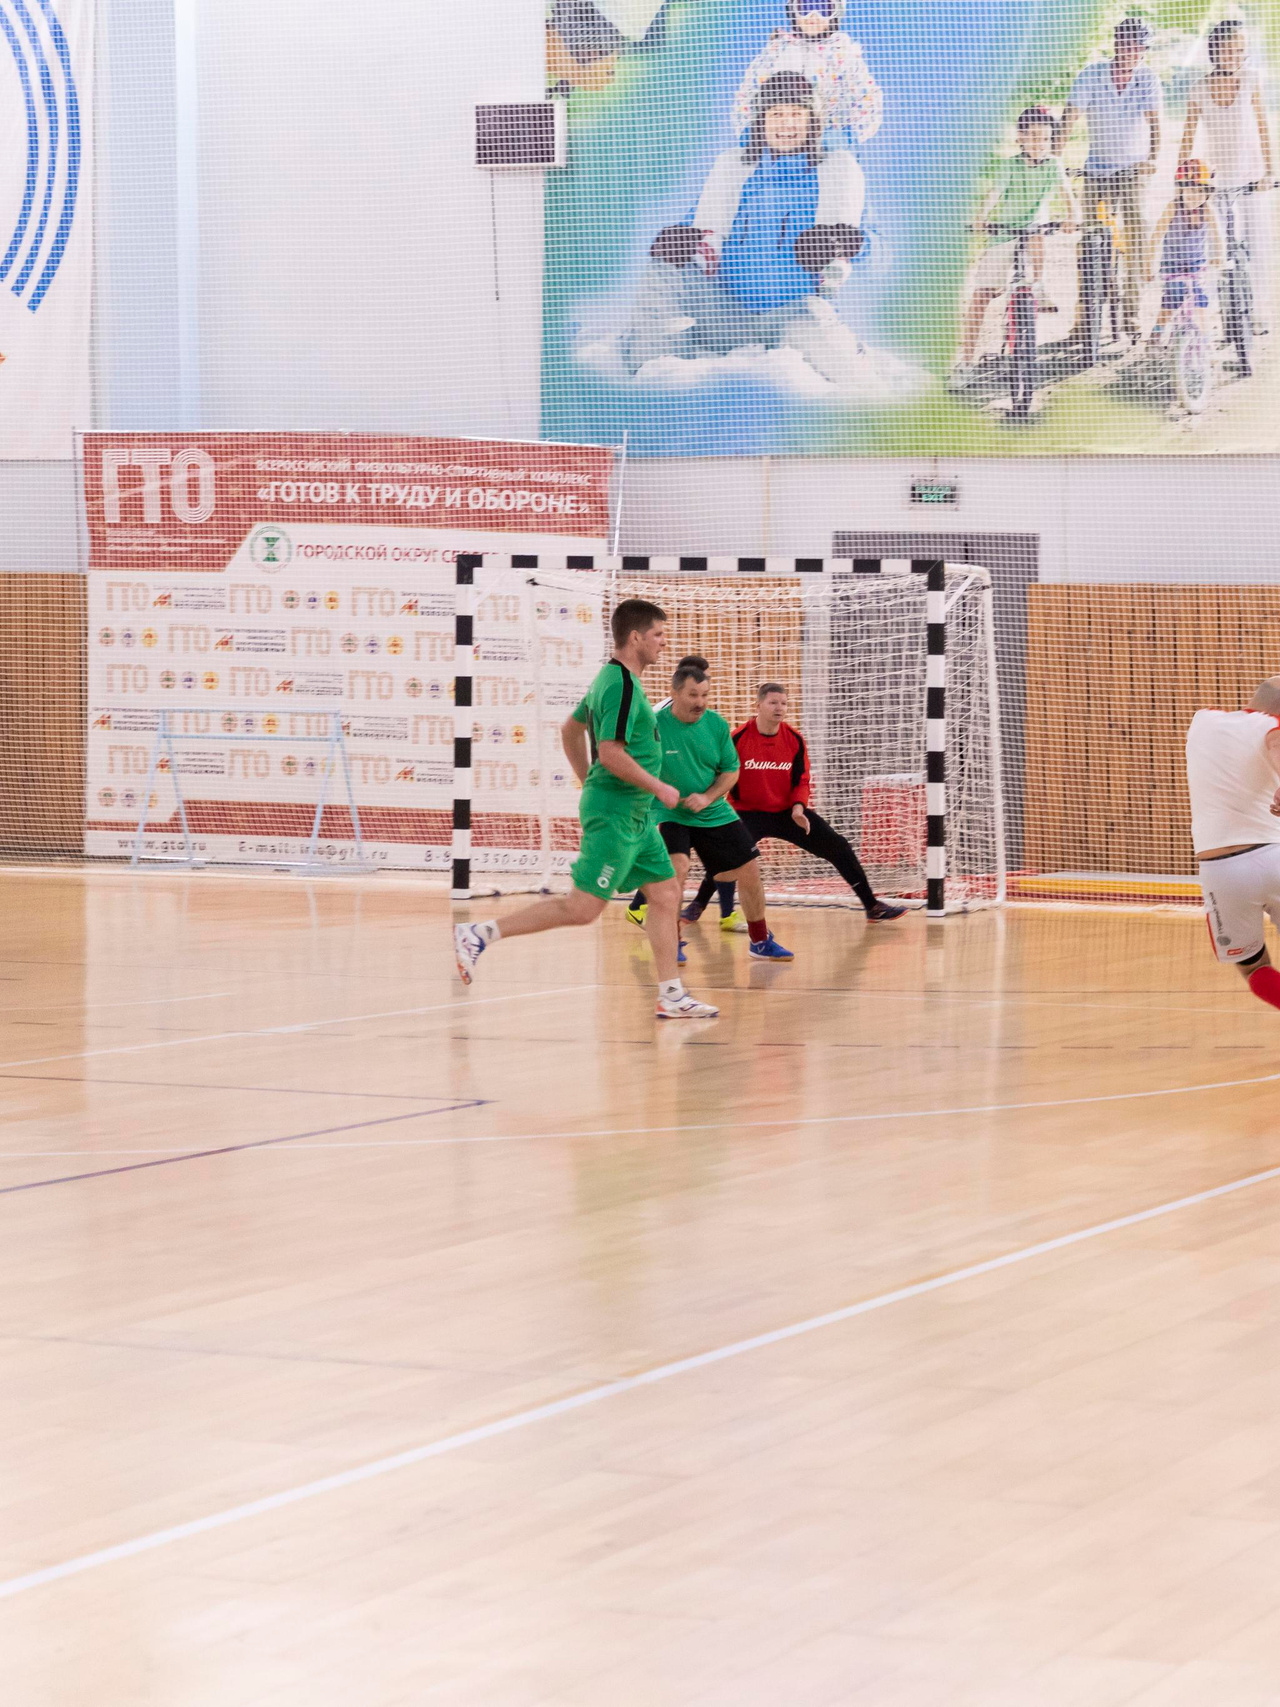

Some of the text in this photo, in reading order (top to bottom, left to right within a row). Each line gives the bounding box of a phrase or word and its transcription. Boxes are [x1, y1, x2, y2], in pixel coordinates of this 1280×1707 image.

[102, 448, 216, 524] ГТО
[257, 481, 591, 514] «ГОТОВ К ТРУДУ И ОБОРОНЕ»
[296, 544, 388, 561] ГОРОДСКОЙ
[391, 547, 438, 563] ОКРУГ
[106, 582, 149, 611] ГТО
[229, 583, 272, 614] ГТО
[351, 587, 395, 616] ГТО
[168, 624, 210, 653] ГТО
[290, 627, 331, 656] ГТО
[106, 664, 149, 694] ГТО
[229, 667, 270, 697] ГТО
[349, 670, 394, 700] ГТО
[107, 745, 149, 775] ГТО
[228, 749, 270, 779] ГТО
[744, 758, 792, 770] Динамо
